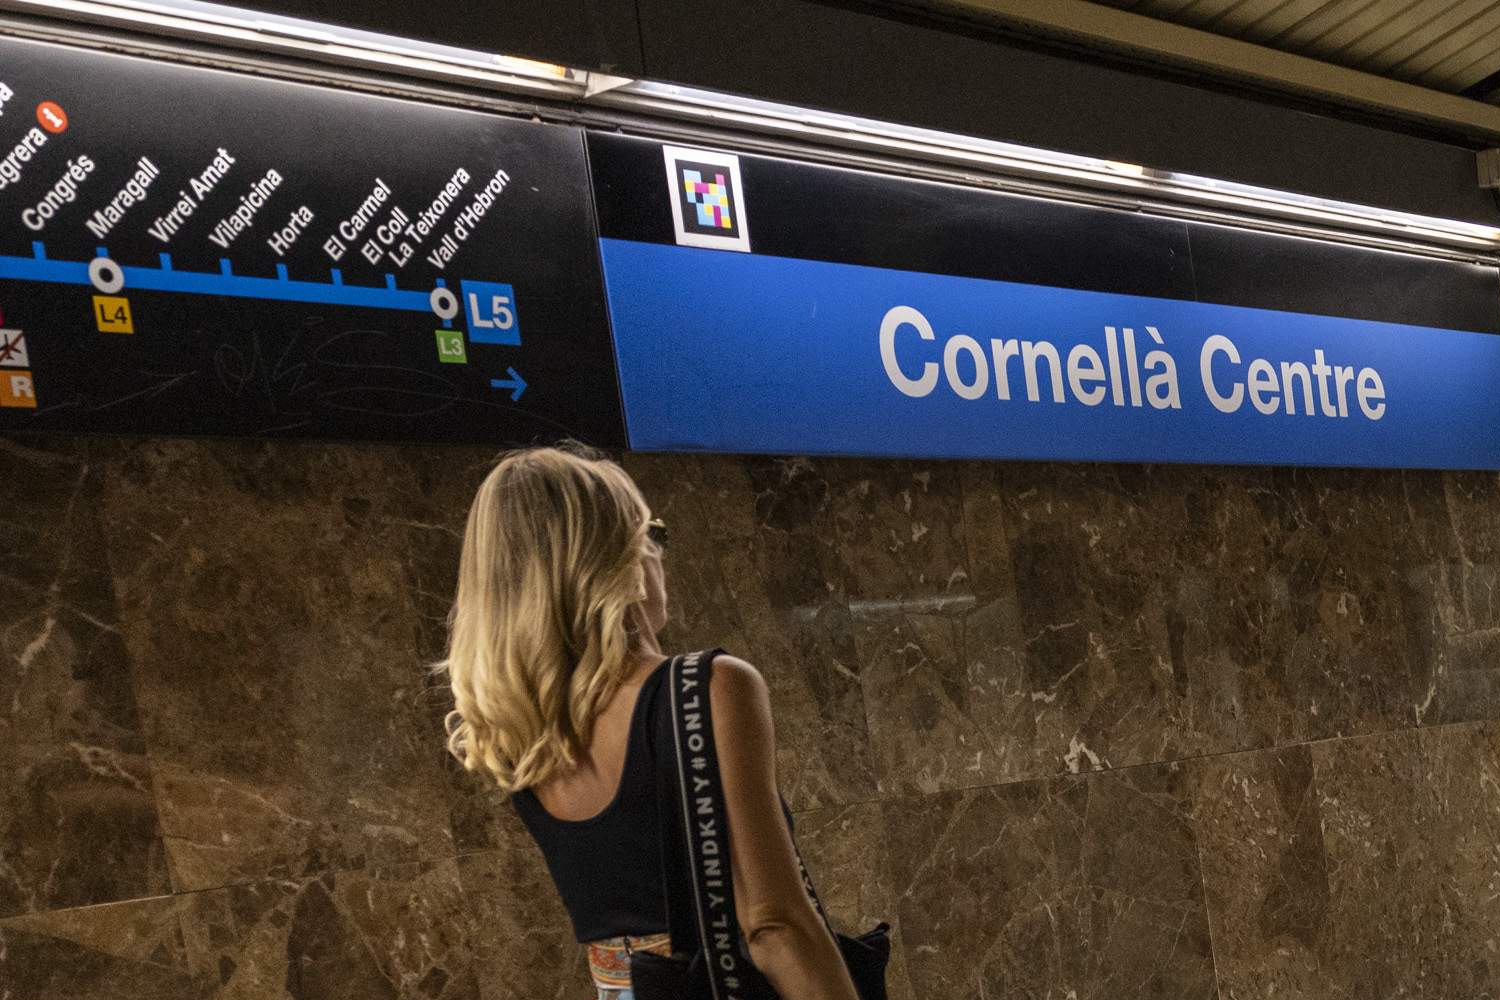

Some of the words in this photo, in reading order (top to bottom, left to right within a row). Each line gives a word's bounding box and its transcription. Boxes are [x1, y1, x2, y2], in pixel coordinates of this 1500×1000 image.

[22, 155, 95, 230] Congrés
[85, 156, 160, 239] Maragall
[148, 190, 198, 243] Virrei
[188, 147, 236, 200] Amat
[208, 168, 283, 248] Vilapicina
[322, 235, 347, 262] El
[339, 177, 392, 242] Carmel
[388, 241, 414, 268] La
[404, 167, 471, 244] Teixonera
[267, 204, 315, 256] Horta
[361, 239, 384, 266] El
[376, 206, 410, 245] Coll
[427, 234, 459, 270] Vall
[100, 304, 128, 324] L4
[468, 292, 514, 331] L5
[439, 336, 464, 356] L3
[878, 305, 1183, 410] Cornellà
[1199, 334, 1386, 421] Centre
[10, 375, 34, 399] R
